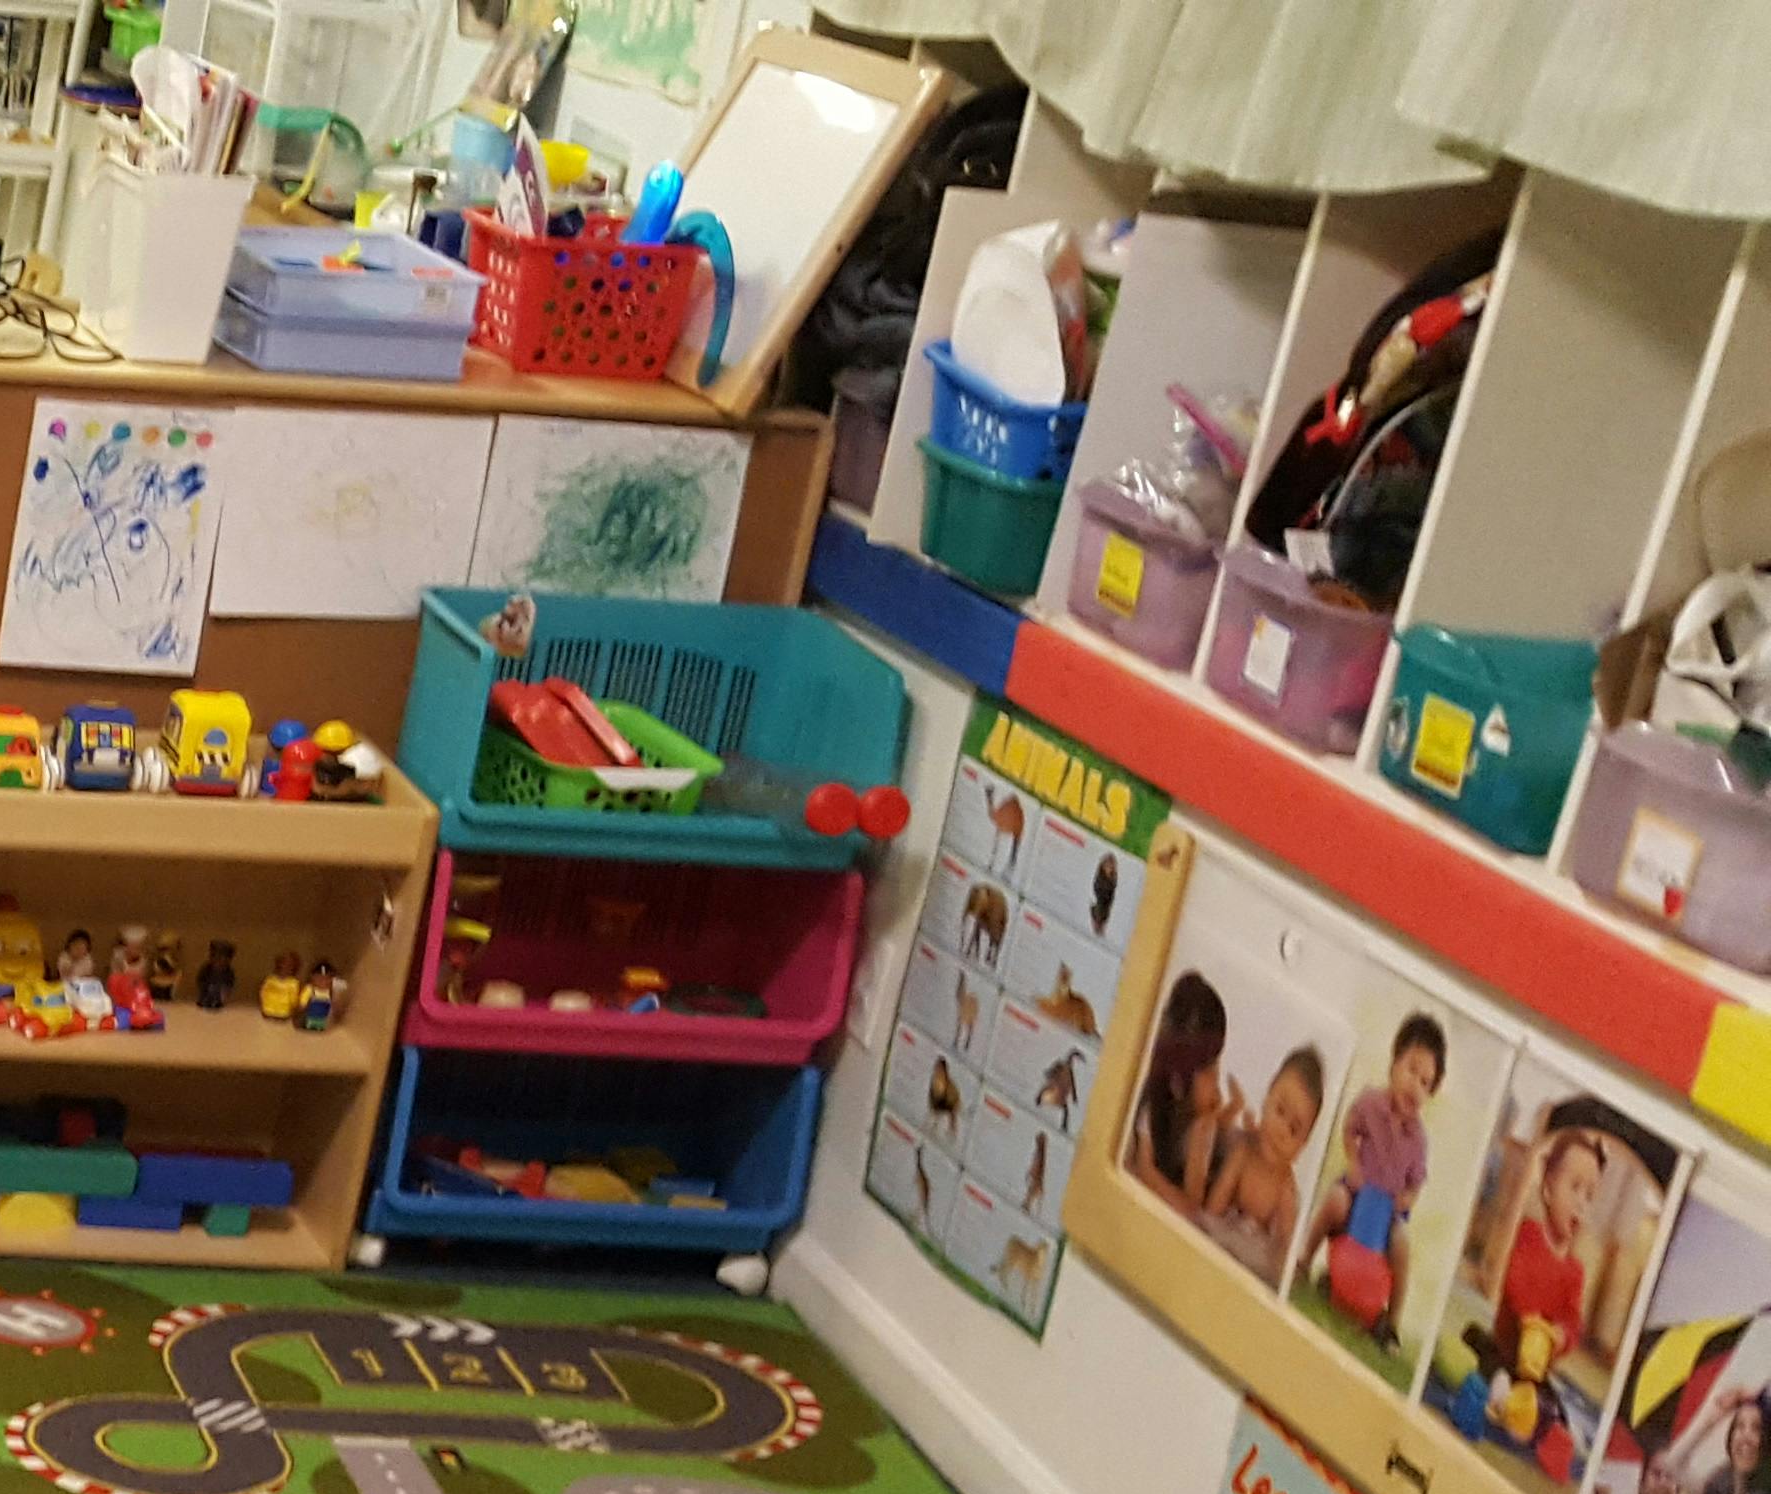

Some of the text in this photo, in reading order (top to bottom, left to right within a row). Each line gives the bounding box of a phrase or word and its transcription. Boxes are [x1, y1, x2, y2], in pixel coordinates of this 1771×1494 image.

[981, 710, 1132, 840] ANIMALS
[351, 1346, 590, 1395] 1 2 3
